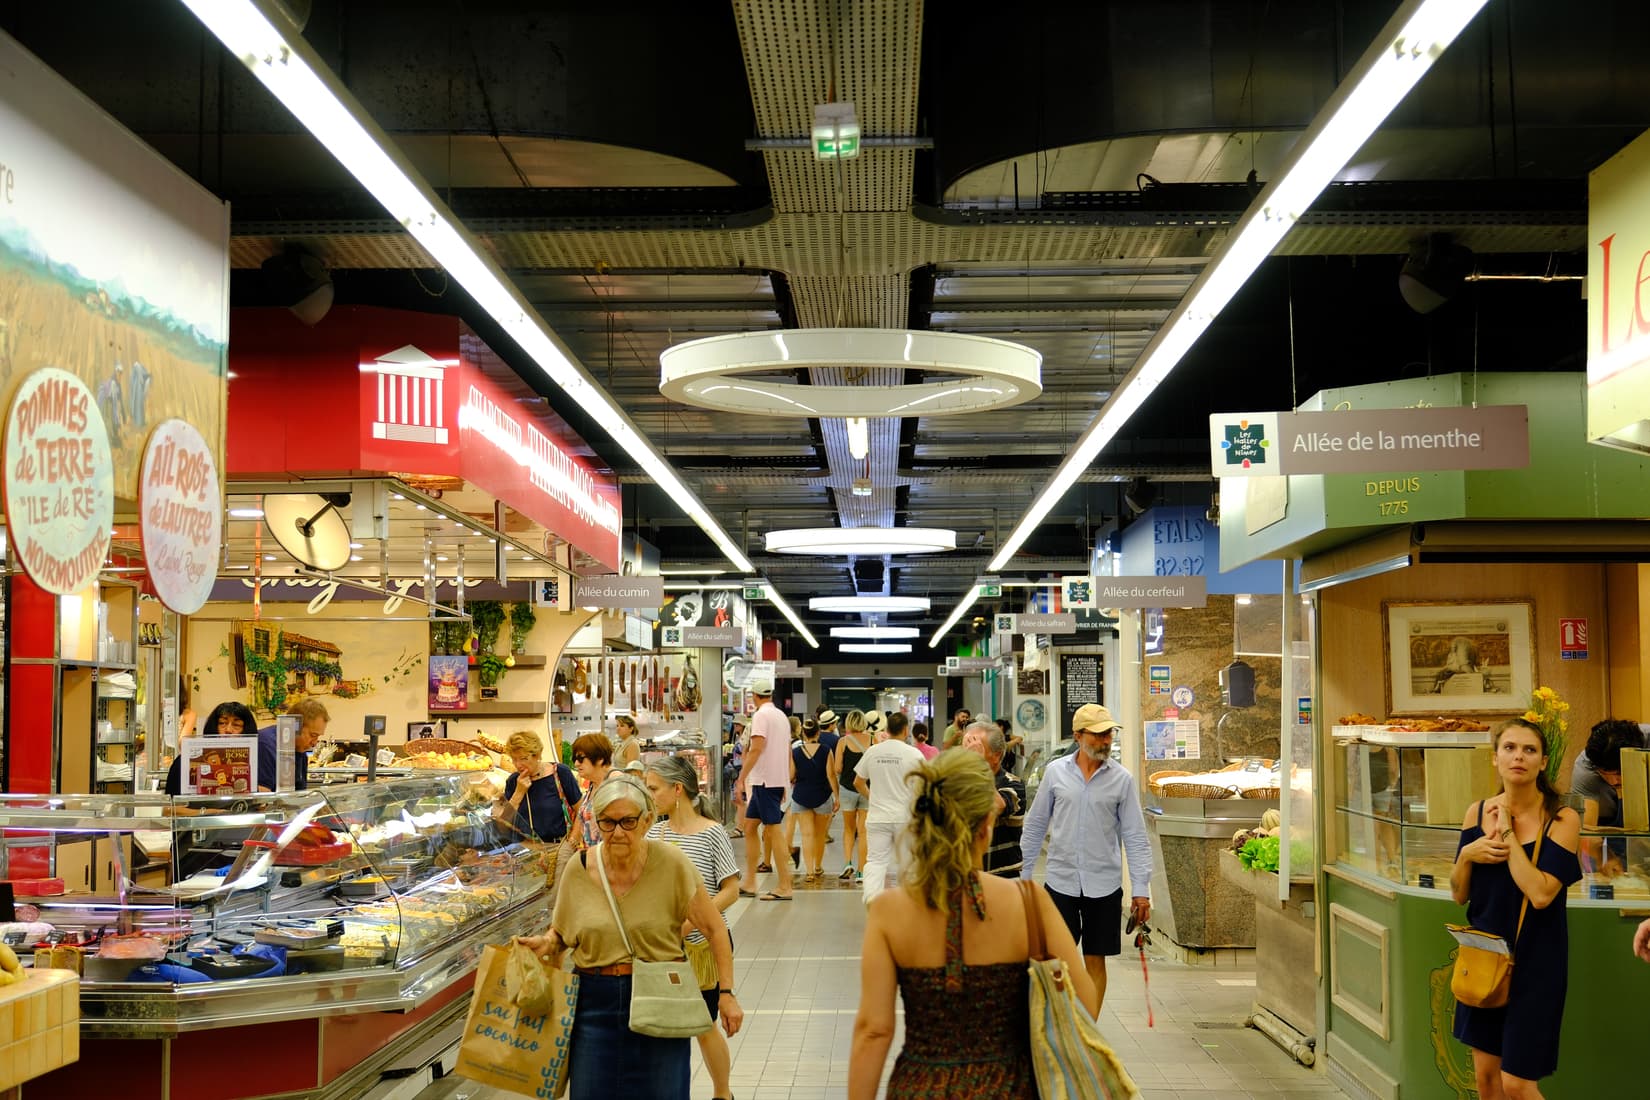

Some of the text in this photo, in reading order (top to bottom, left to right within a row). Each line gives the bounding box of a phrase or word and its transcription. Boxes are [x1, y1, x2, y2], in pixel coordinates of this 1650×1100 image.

[17, 378, 89, 446] POMMES
[1293, 428, 1480, 452] Allée de la menthe
[16, 437, 95, 485] de TERRE
[176, 448, 210, 502] ROSE
[1366, 477, 1420, 497] DEPUIS
[54, 487, 70, 519] de
[150, 498, 162, 529] de
[1380, 500, 1409, 517] 1775
[1154, 518, 1204, 544] ETALS
[24, 524, 108, 592] NOIRMOUTIER
[577, 586, 650, 598] Allée du cumin
[1103, 586, 1185, 598] Allée du cerfeuil
[482, 1001, 512, 1020] sac
[476, 1023, 541, 1053] cocorico
